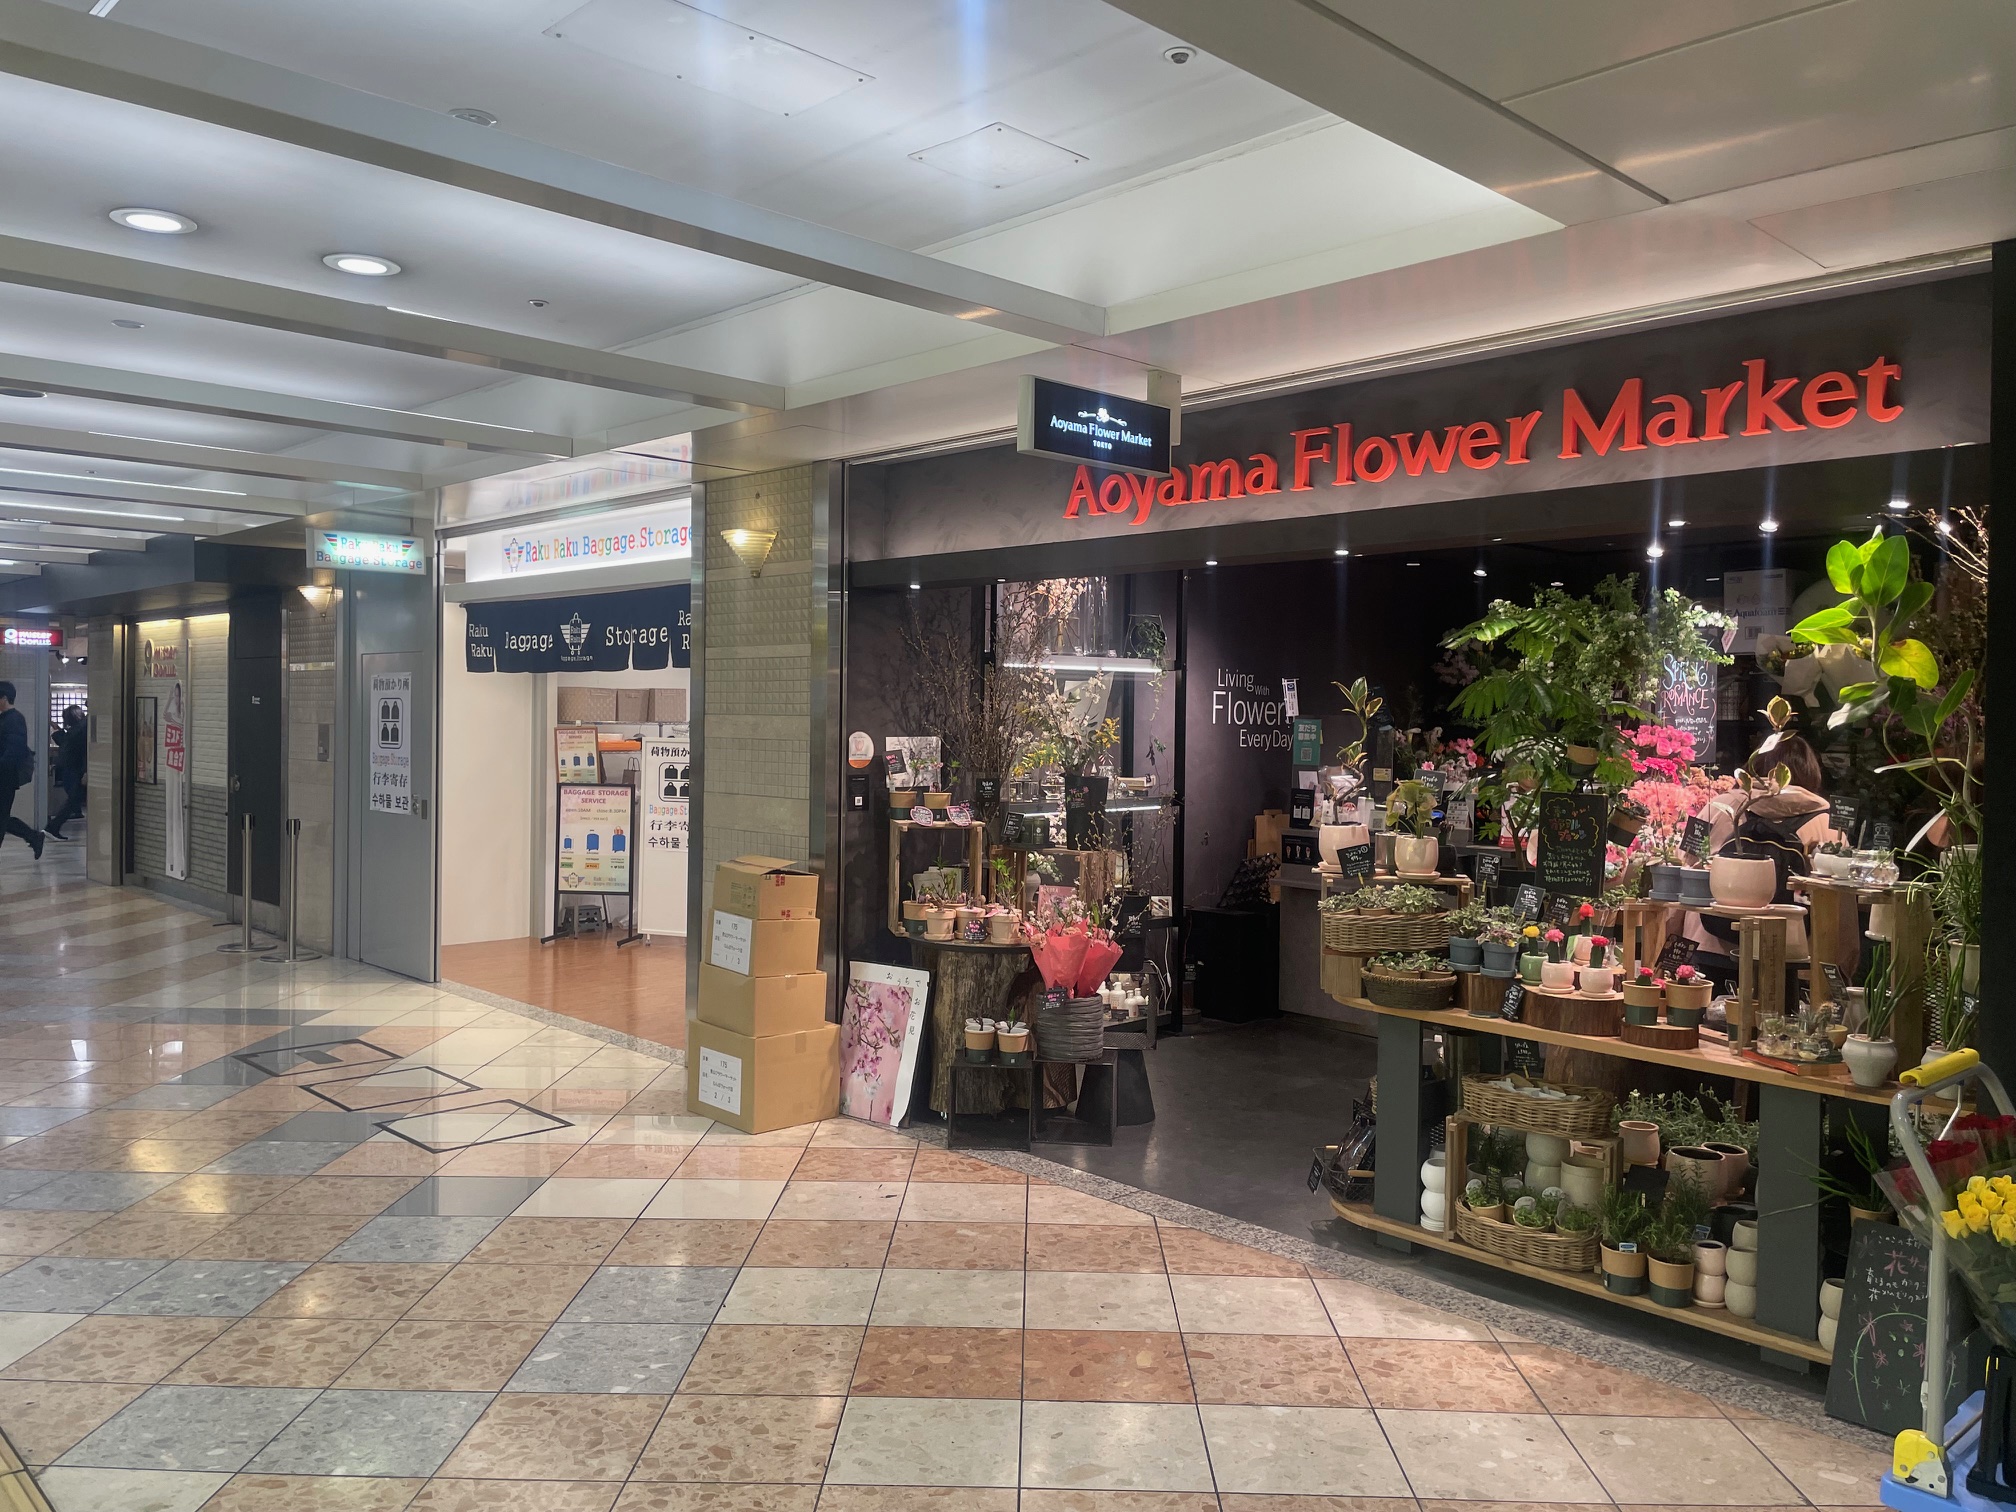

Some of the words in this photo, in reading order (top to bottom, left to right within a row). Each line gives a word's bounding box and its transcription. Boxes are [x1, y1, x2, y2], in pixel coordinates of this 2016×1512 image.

[1050, 415, 1088, 434] Aoyama
[1088, 422, 1120, 441] Flower
[1121, 429, 1152, 447] Market
[1062, 453, 1281, 526] Aoyama
[1290, 410, 1543, 491] Flower
[1557, 355, 1904, 459] Market
[525, 540, 550, 563] Raku
[553, 537, 579, 559] Raku
[605, 625, 668, 647] Storage
[471, 643, 493, 658] Raku
[1218, 668, 1254, 692] Living
[1662, 654, 1707, 690] SPRNG
[1254, 685, 1270, 696] With
[1661, 681, 1710, 716] ROMANCE
[1212, 690, 1290, 726] Flower
[651, 746, 690, 757] 荷物預か
[372, 771, 408, 788] 行李寄存
[371, 793, 392, 809] 수하물
[394, 795, 409, 811] 보관
[648, 836, 681, 849] 수하물
